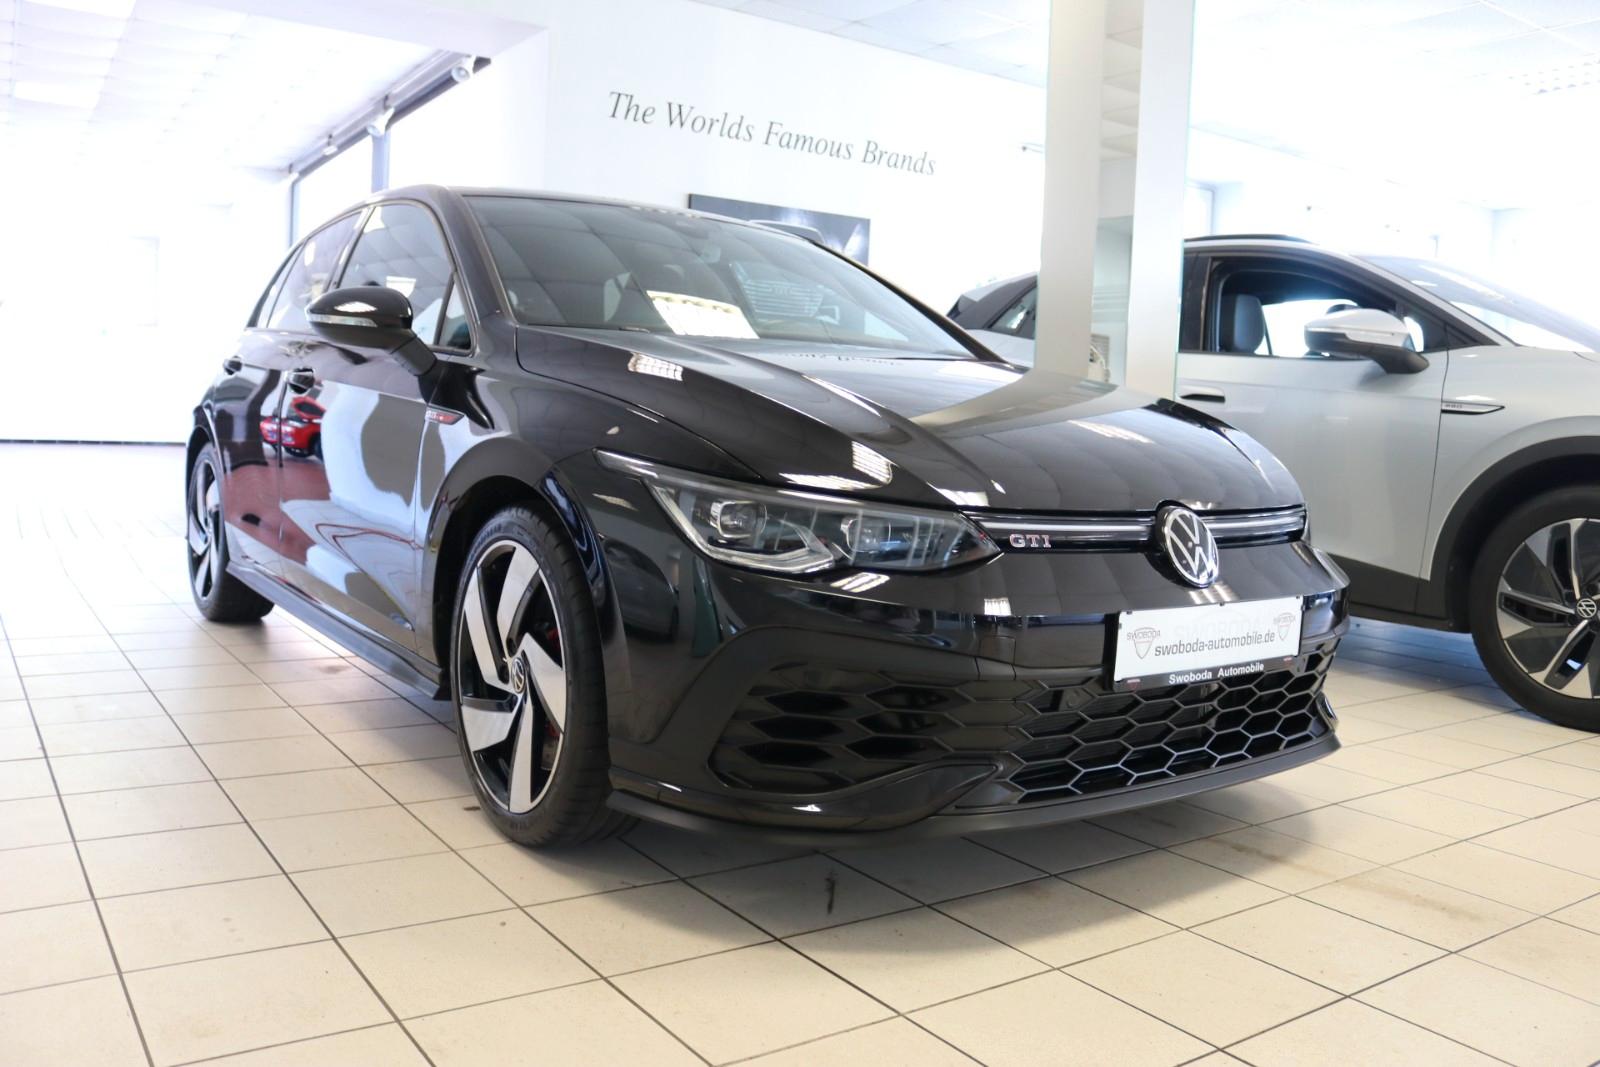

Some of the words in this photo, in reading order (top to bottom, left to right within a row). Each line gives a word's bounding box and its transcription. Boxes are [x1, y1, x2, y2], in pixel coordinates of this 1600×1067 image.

[608, 91, 656, 125] The
[666, 101, 756, 143] Worlds
[763, 120, 854, 161] Famous
[861, 139, 936, 176] Brands
[1009, 533, 1052, 549] GTI
[1127, 630, 1161, 640] SWOBODA
[1155, 630, 1276, 656] swoboda-automobile.de
[1168, 669, 1213, 685] Swoboda
[1217, 662, 1265, 678] Automobile
